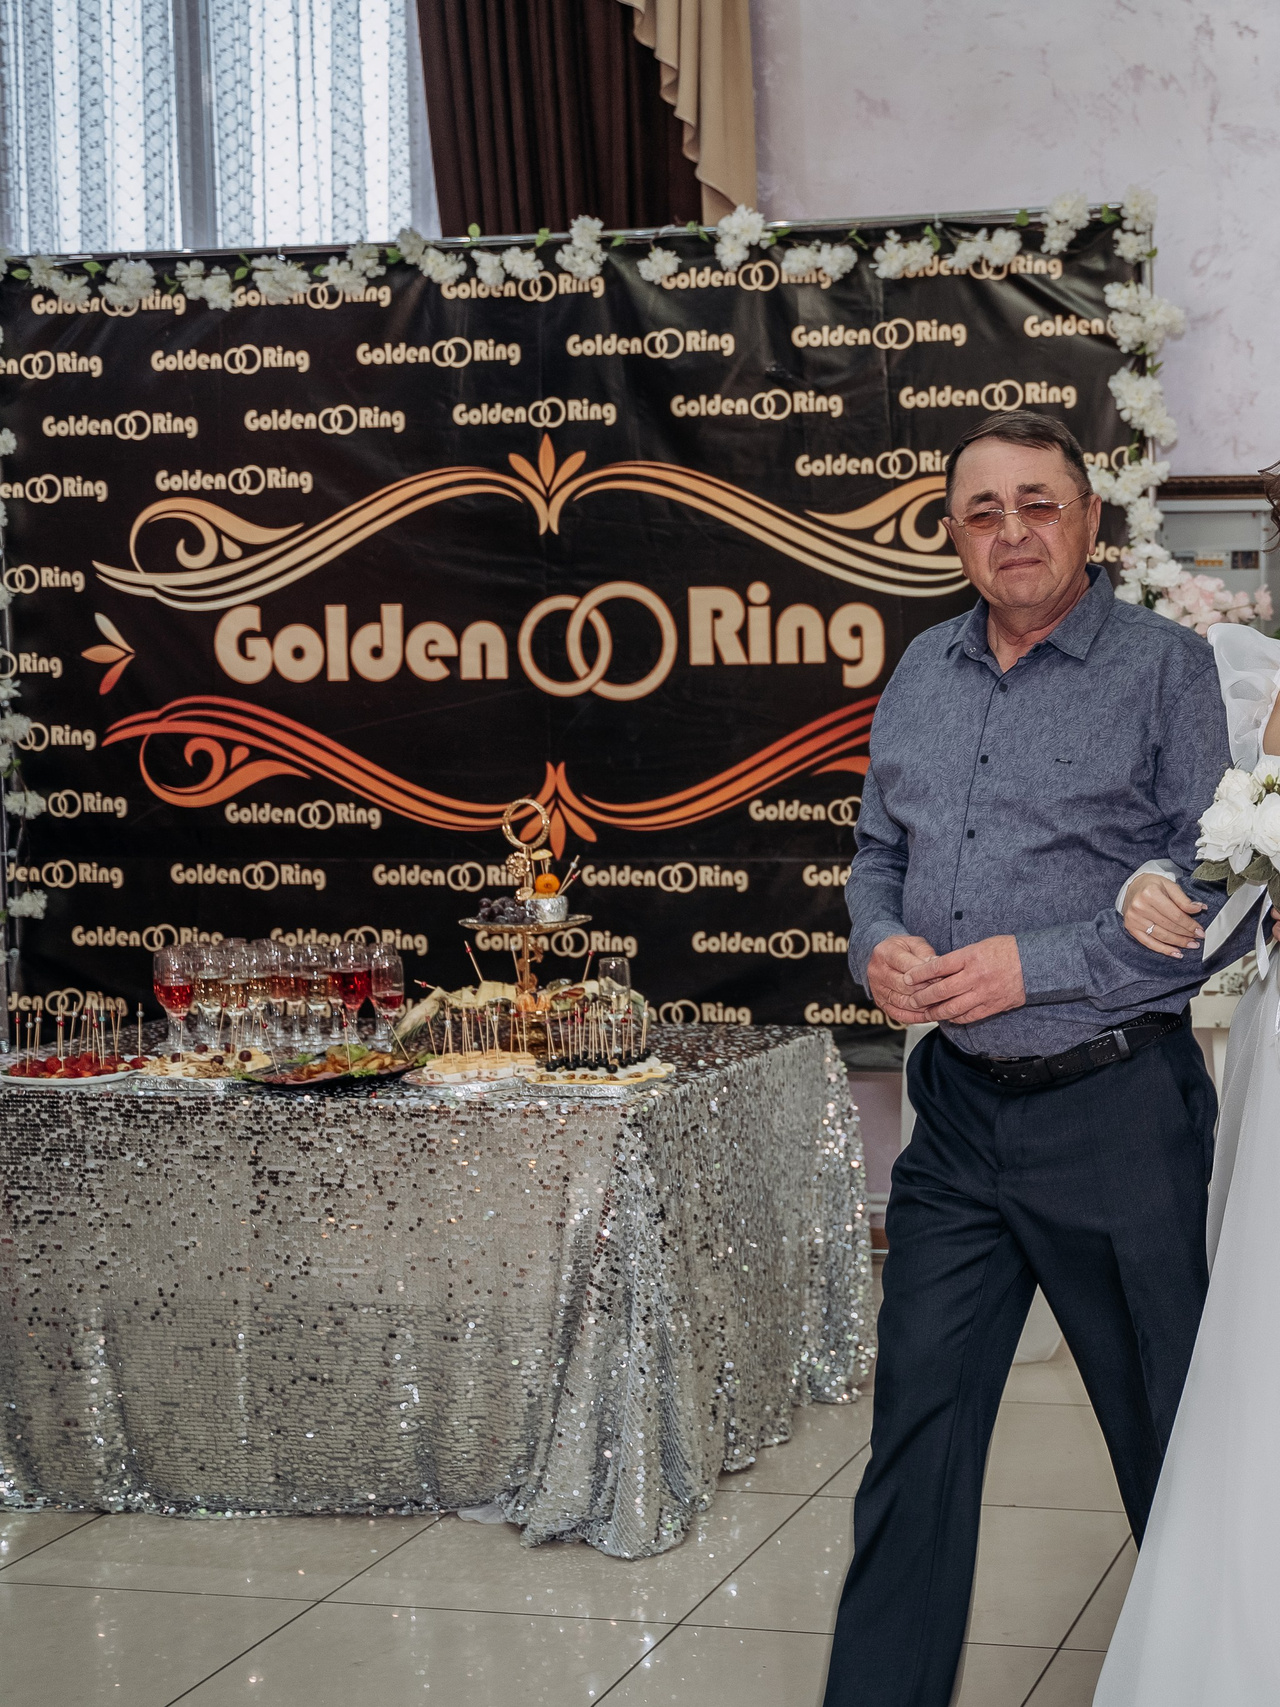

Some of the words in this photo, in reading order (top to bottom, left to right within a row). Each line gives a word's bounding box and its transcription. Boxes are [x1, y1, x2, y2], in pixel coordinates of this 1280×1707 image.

[661, 266, 737, 290] Golden
[1010, 254, 1062, 280] Ring
[791, 325, 871, 348] Golden
[915, 319, 968, 347] Ring
[1023, 314, 1105, 338] Golden
[356, 342, 430, 366] Golden
[473, 338, 521, 366] Ring
[566, 334, 642, 357] Golden
[686, 329, 735, 357] Ring
[57, 351, 103, 378] Ring
[151, 349, 222, 371] Golden
[262, 345, 310, 373] Ring
[670, 394, 749, 418] Golden
[793, 390, 843, 418] Ring
[899, 385, 980, 409] Golden
[1025, 381, 1077, 409] Ring
[42, 415, 113, 437] Golden
[152, 412, 199, 439] Ring
[244, 409, 317, 432] Golden
[359, 406, 406, 433] Ring
[452, 402, 527, 426] Golden
[567, 398, 617, 426] Ring
[795, 453, 874, 477] Golden
[63, 476, 108, 502] Ring
[155, 469, 227, 491] Golden
[266, 466, 314, 494] Ring
[40, 566, 86, 593] Ring
[214, 603, 510, 685] Golden
[688, 581, 885, 689] Ring
[19, 652, 63, 679] Ring
[50, 724, 97, 751] Ring
[82, 792, 128, 819] Ring
[225, 802, 296, 824] Golden
[336, 801, 382, 830] Ring
[749, 799, 827, 821] Golden
[78, 862, 124, 889] Ring
[170, 863, 241, 885] Golden
[280, 863, 326, 890] Ring
[372, 864, 446, 886] Golden
[581, 864, 657, 887] Golden
[699, 865, 749, 893] Ring
[71, 925, 141, 947] Golden
[381, 929, 428, 957] Ring
[591, 930, 638, 958] Ring
[692, 931, 767, 953] Golden
[701, 1003, 750, 1026] Ring
[804, 1003, 884, 1024] Golden
